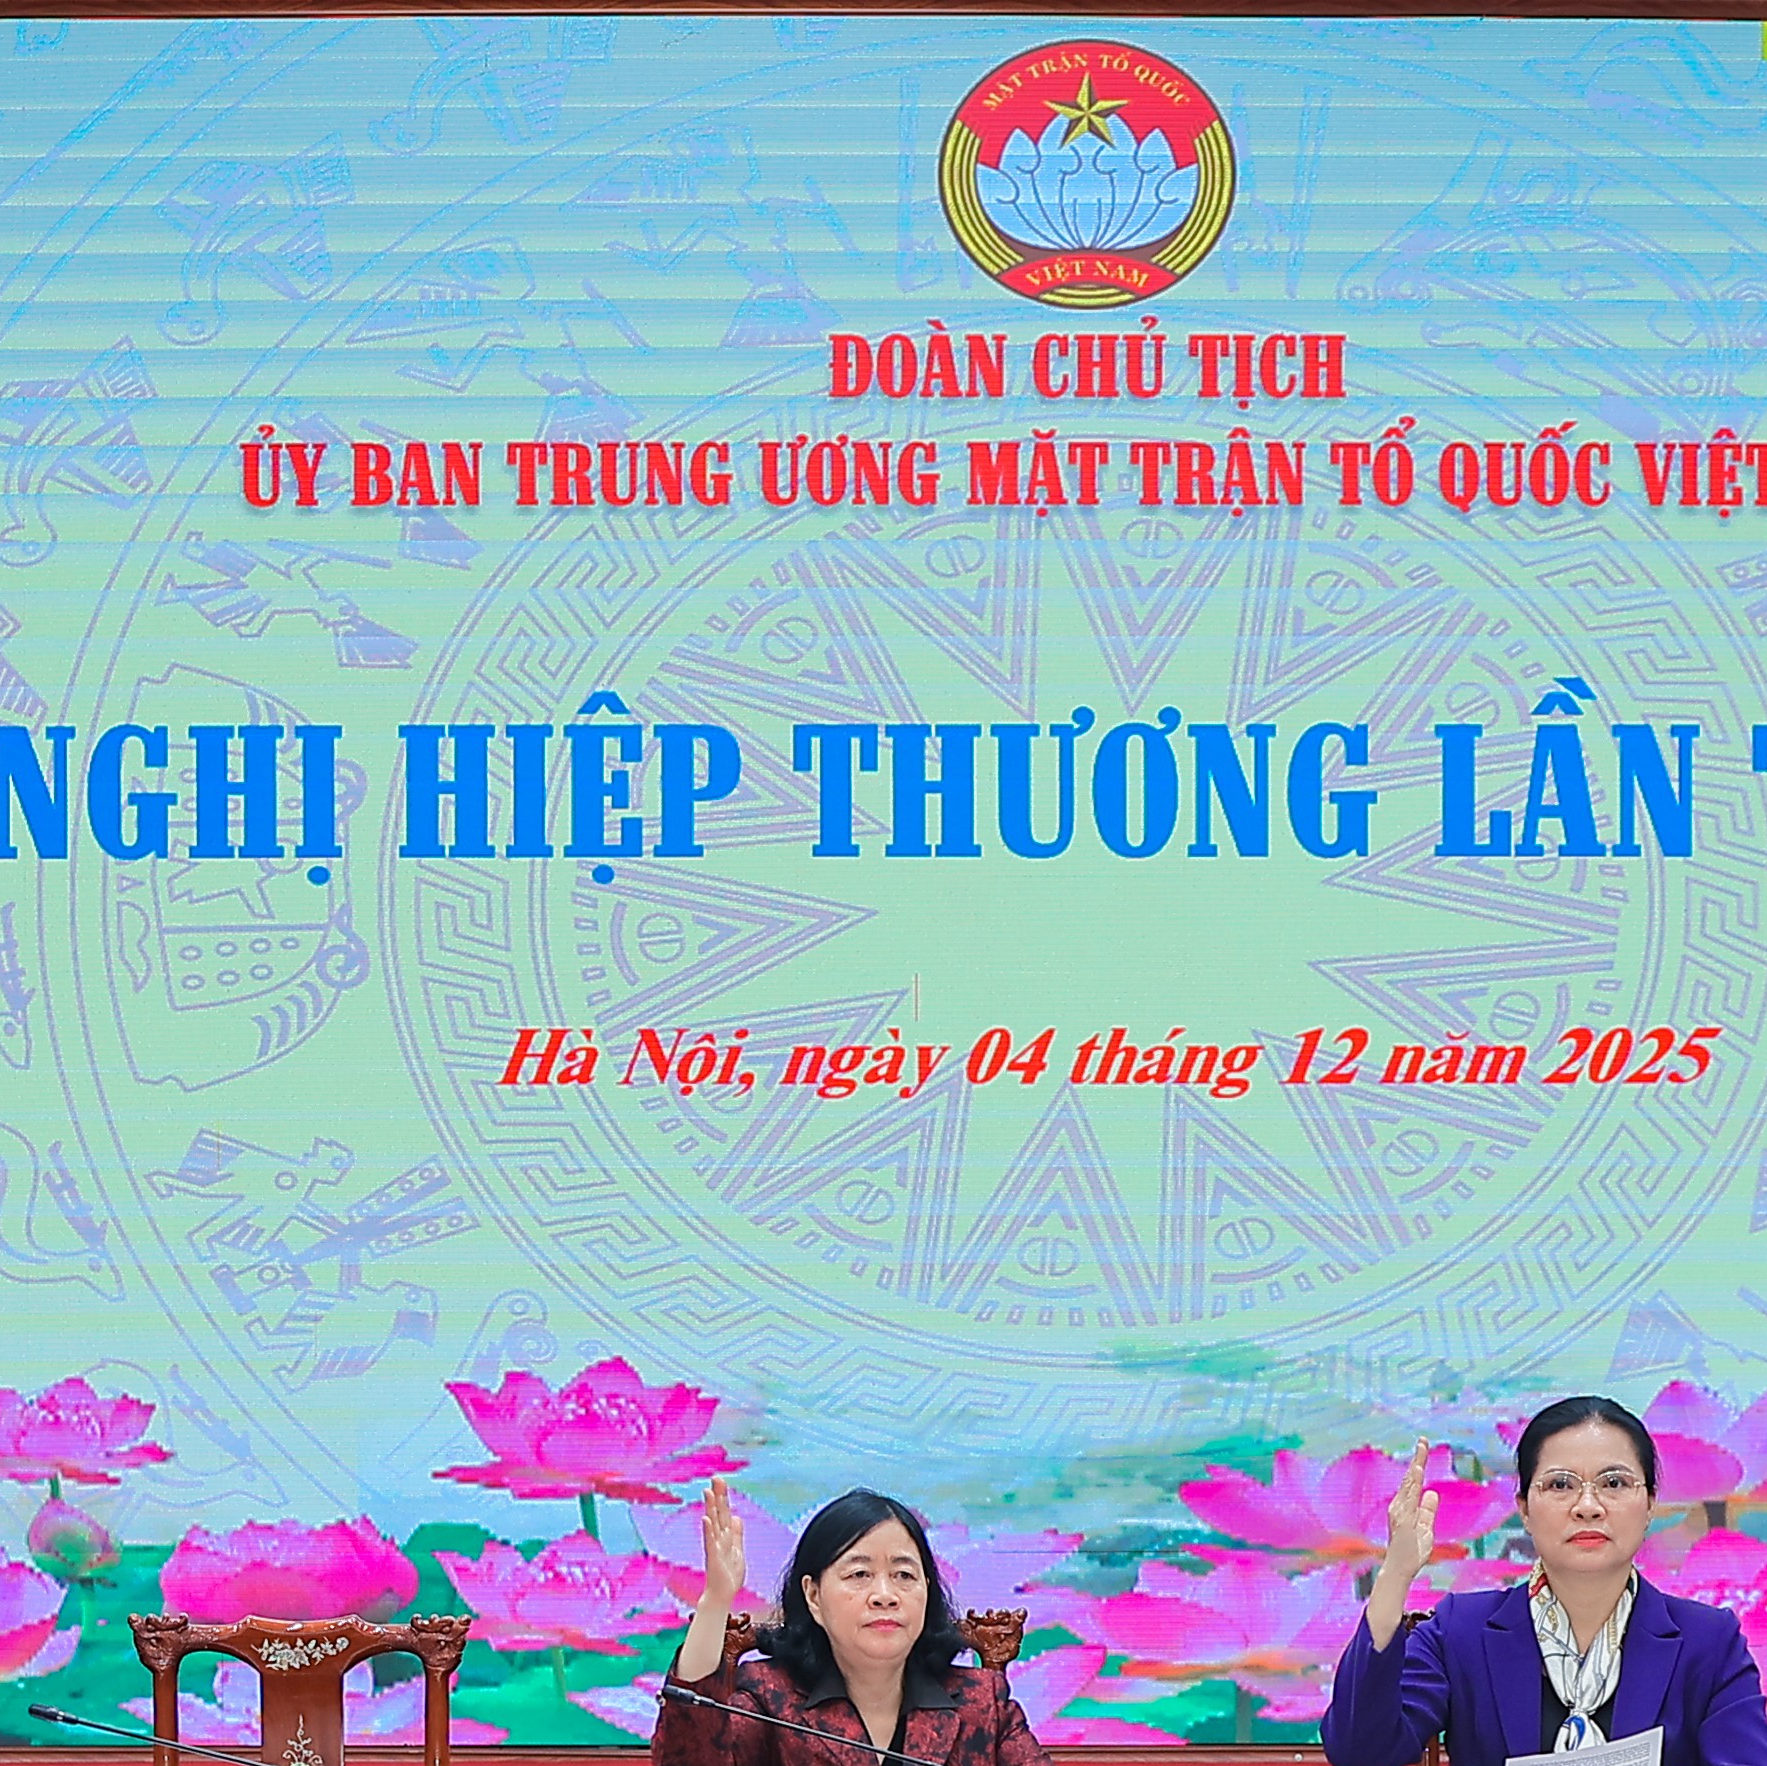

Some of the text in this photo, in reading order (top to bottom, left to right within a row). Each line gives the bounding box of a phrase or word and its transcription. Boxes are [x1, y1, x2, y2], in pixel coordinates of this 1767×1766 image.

[983, 51, 1191, 111] MẶT TRẬN TỔ QUỐC
[1025, 257, 1149, 288] VIỆT NAM
[830, 315, 1347, 410] ĐOÀN CHỦ TỊCH
[240, 424, 326, 508] ỦY
[351, 441, 483, 507] BAN
[506, 440, 733, 507] TRUNG
[759, 434, 940, 507] ƯƠNG
[967, 429, 1109, 518] MẶT
[1130, 427, 1306, 518] TRẬN
[1329, 416, 1416, 507] TỔ
[1438, 421, 1611, 514] QUỐC
[399, 690, 742, 886] HIỆP
[793, 706, 1378, 860] THƯƠNG
[1434, 676, 1701, 859] LẦN
[500, 1027, 1722, 1099] Hà Nội, ngày 04 tháng 12 năm 2025
